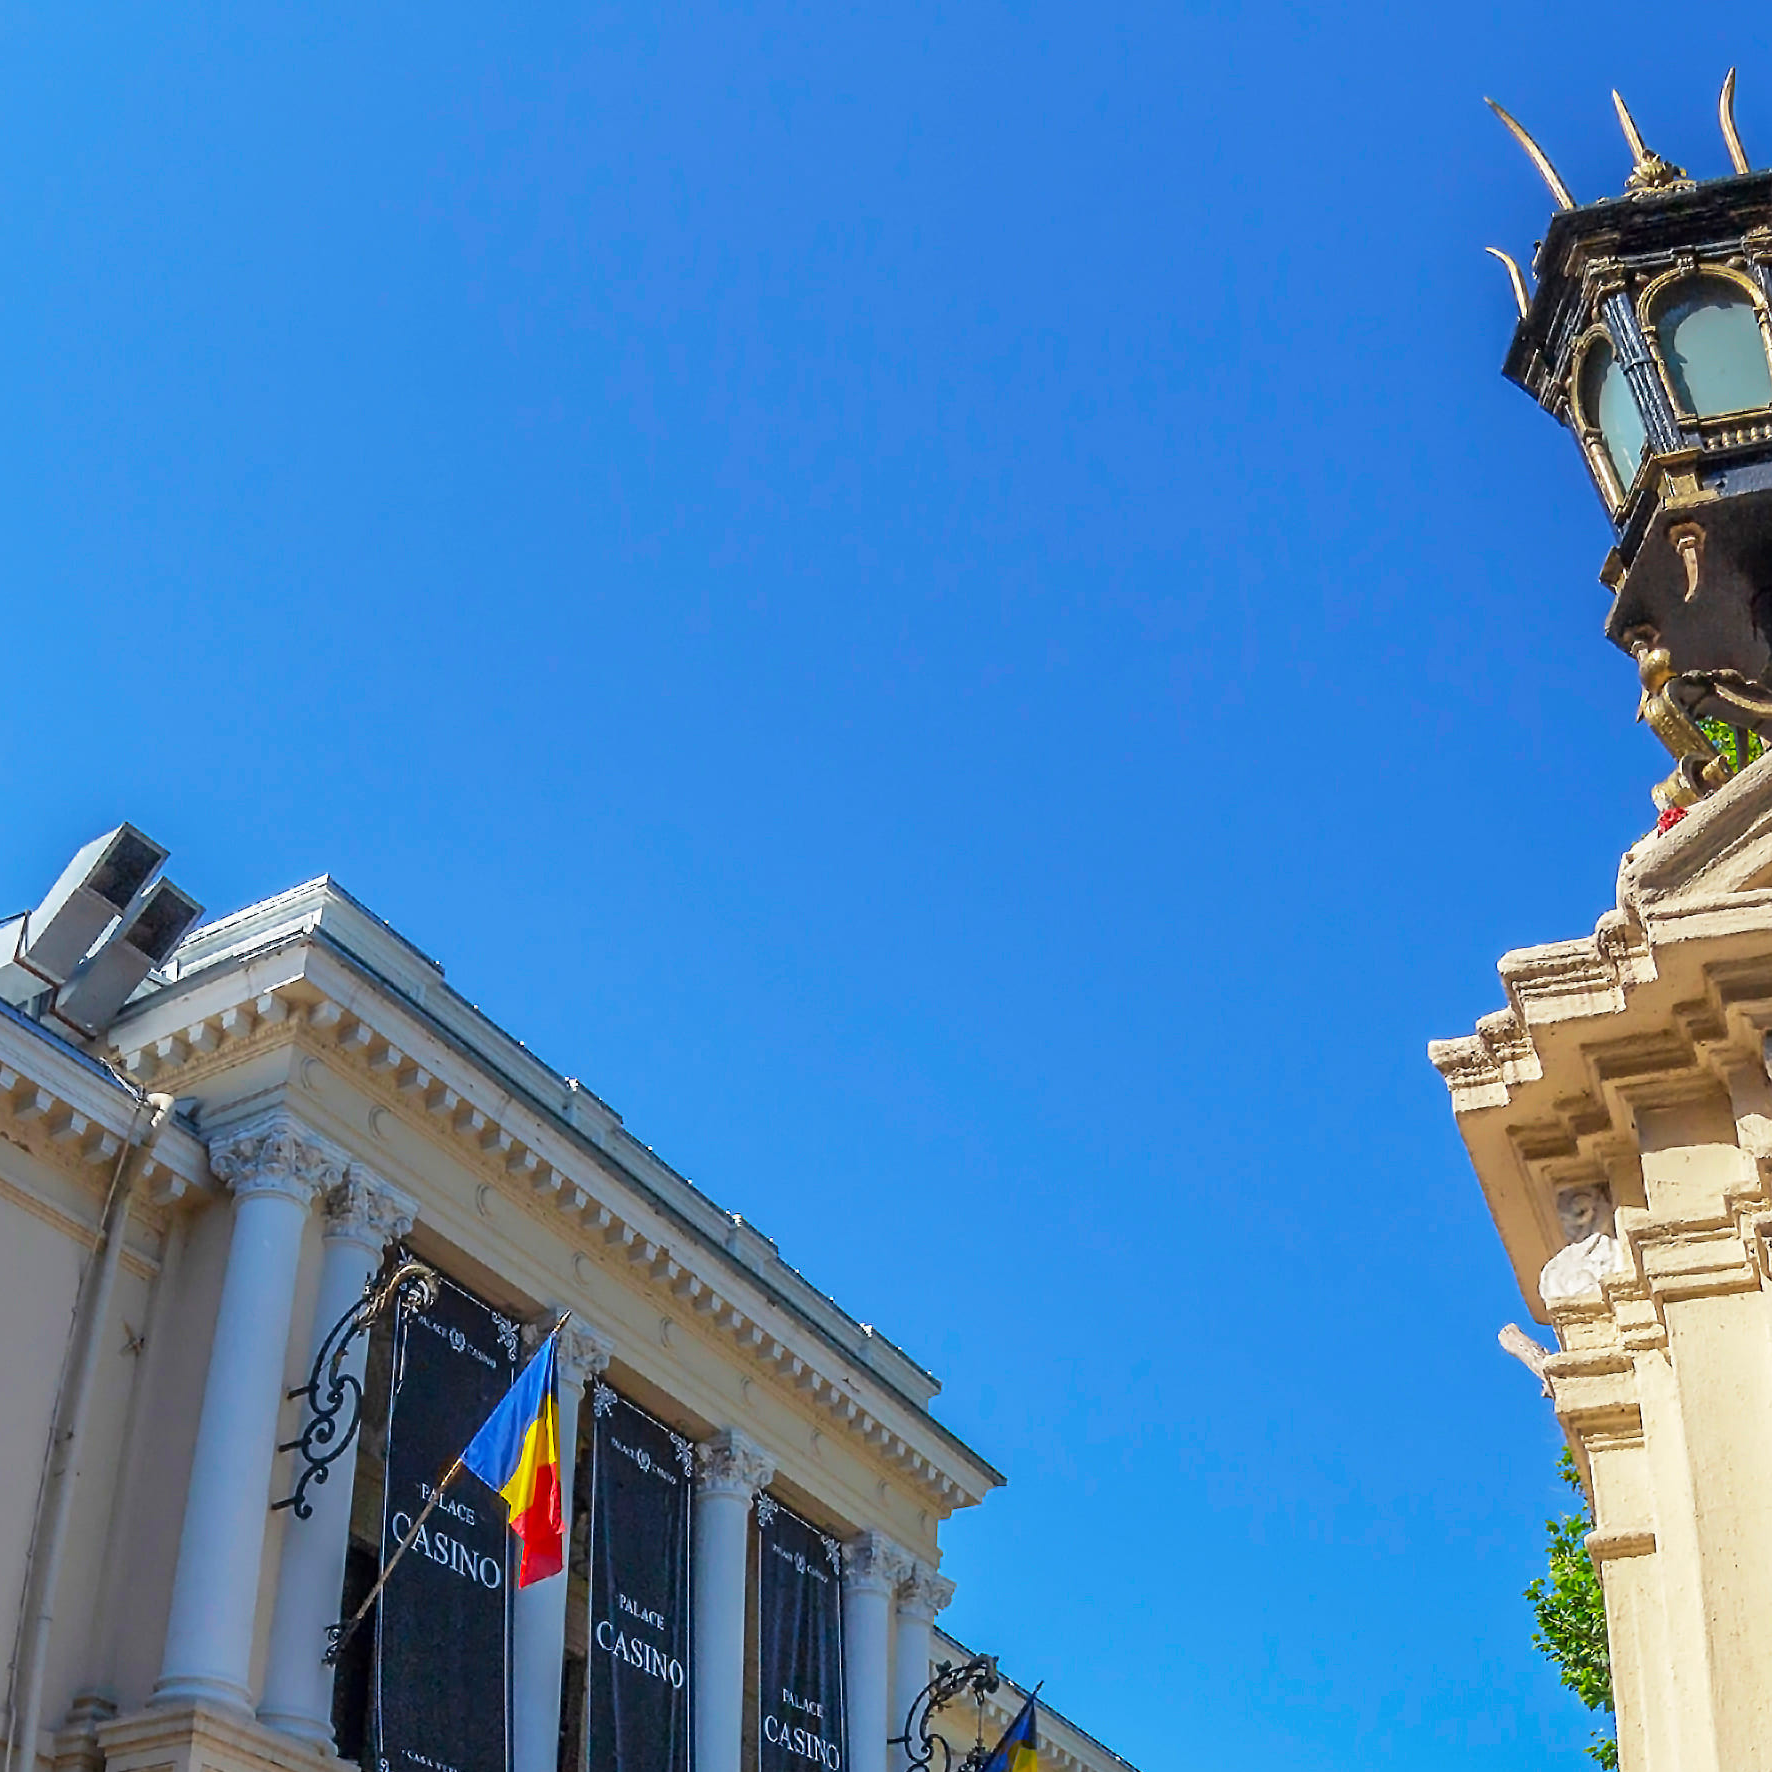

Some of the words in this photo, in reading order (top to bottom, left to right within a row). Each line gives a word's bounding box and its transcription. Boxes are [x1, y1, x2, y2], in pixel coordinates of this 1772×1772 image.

[421, 1483, 475, 1526] PALACE
[392, 1512, 501, 1589] CASINO
[619, 1593, 665, 1631] PALACE
[596, 1620, 684, 1689] CASINO
[782, 1688, 825, 1719] PALACE
[764, 1715, 840, 1771] CASINO
